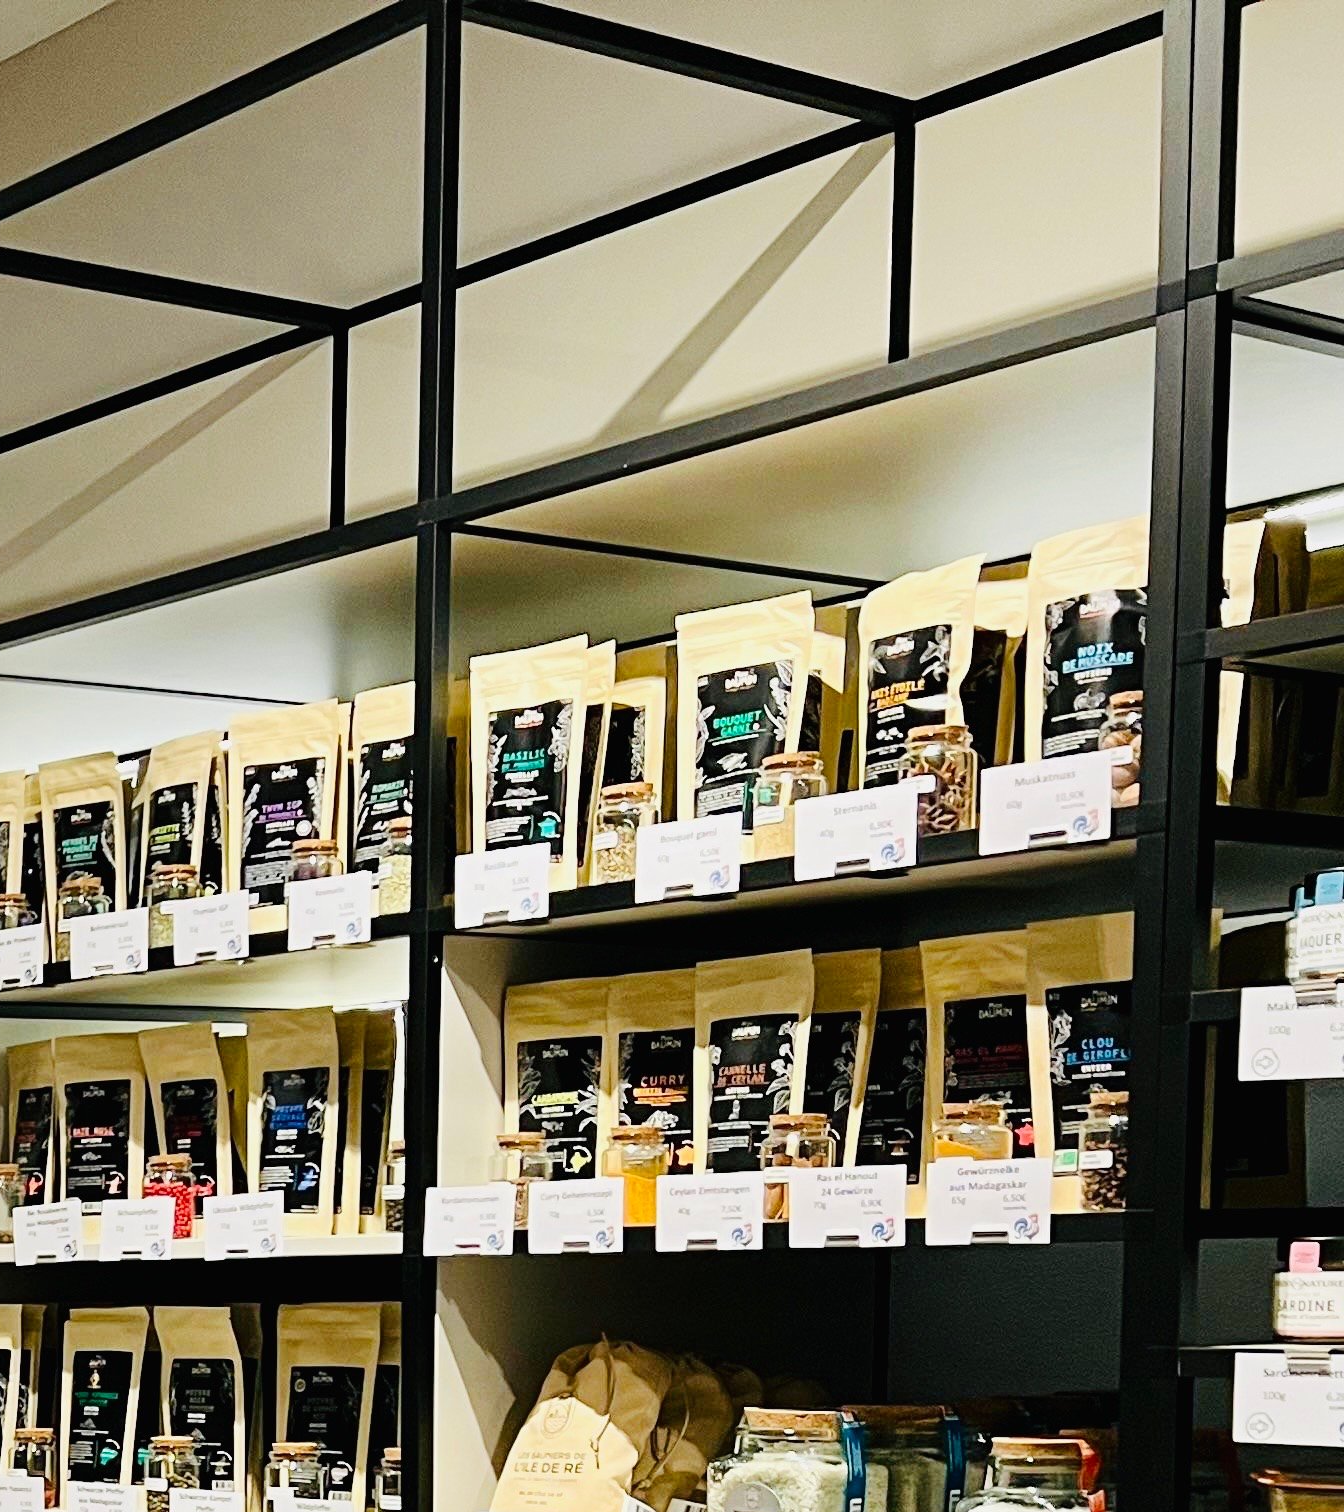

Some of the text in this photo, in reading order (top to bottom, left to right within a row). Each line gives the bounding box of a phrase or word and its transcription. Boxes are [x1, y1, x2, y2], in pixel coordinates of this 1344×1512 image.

[713, 709, 762, 729] BOUQUET
[1014, 769, 1076, 787] Muskatnuss
[1081, 1037, 1114, 1050] CLOU
[1078, 1048, 1133, 1062] GIROFL
[641, 1074, 685, 1087] CURRY
[957, 1166, 1020, 1178] Gewürznelke
[968, 1180, 1028, 1194] Madagaskar
[542, 1462, 559, 1474] DE
[564, 1460, 584, 1474] RÉ
